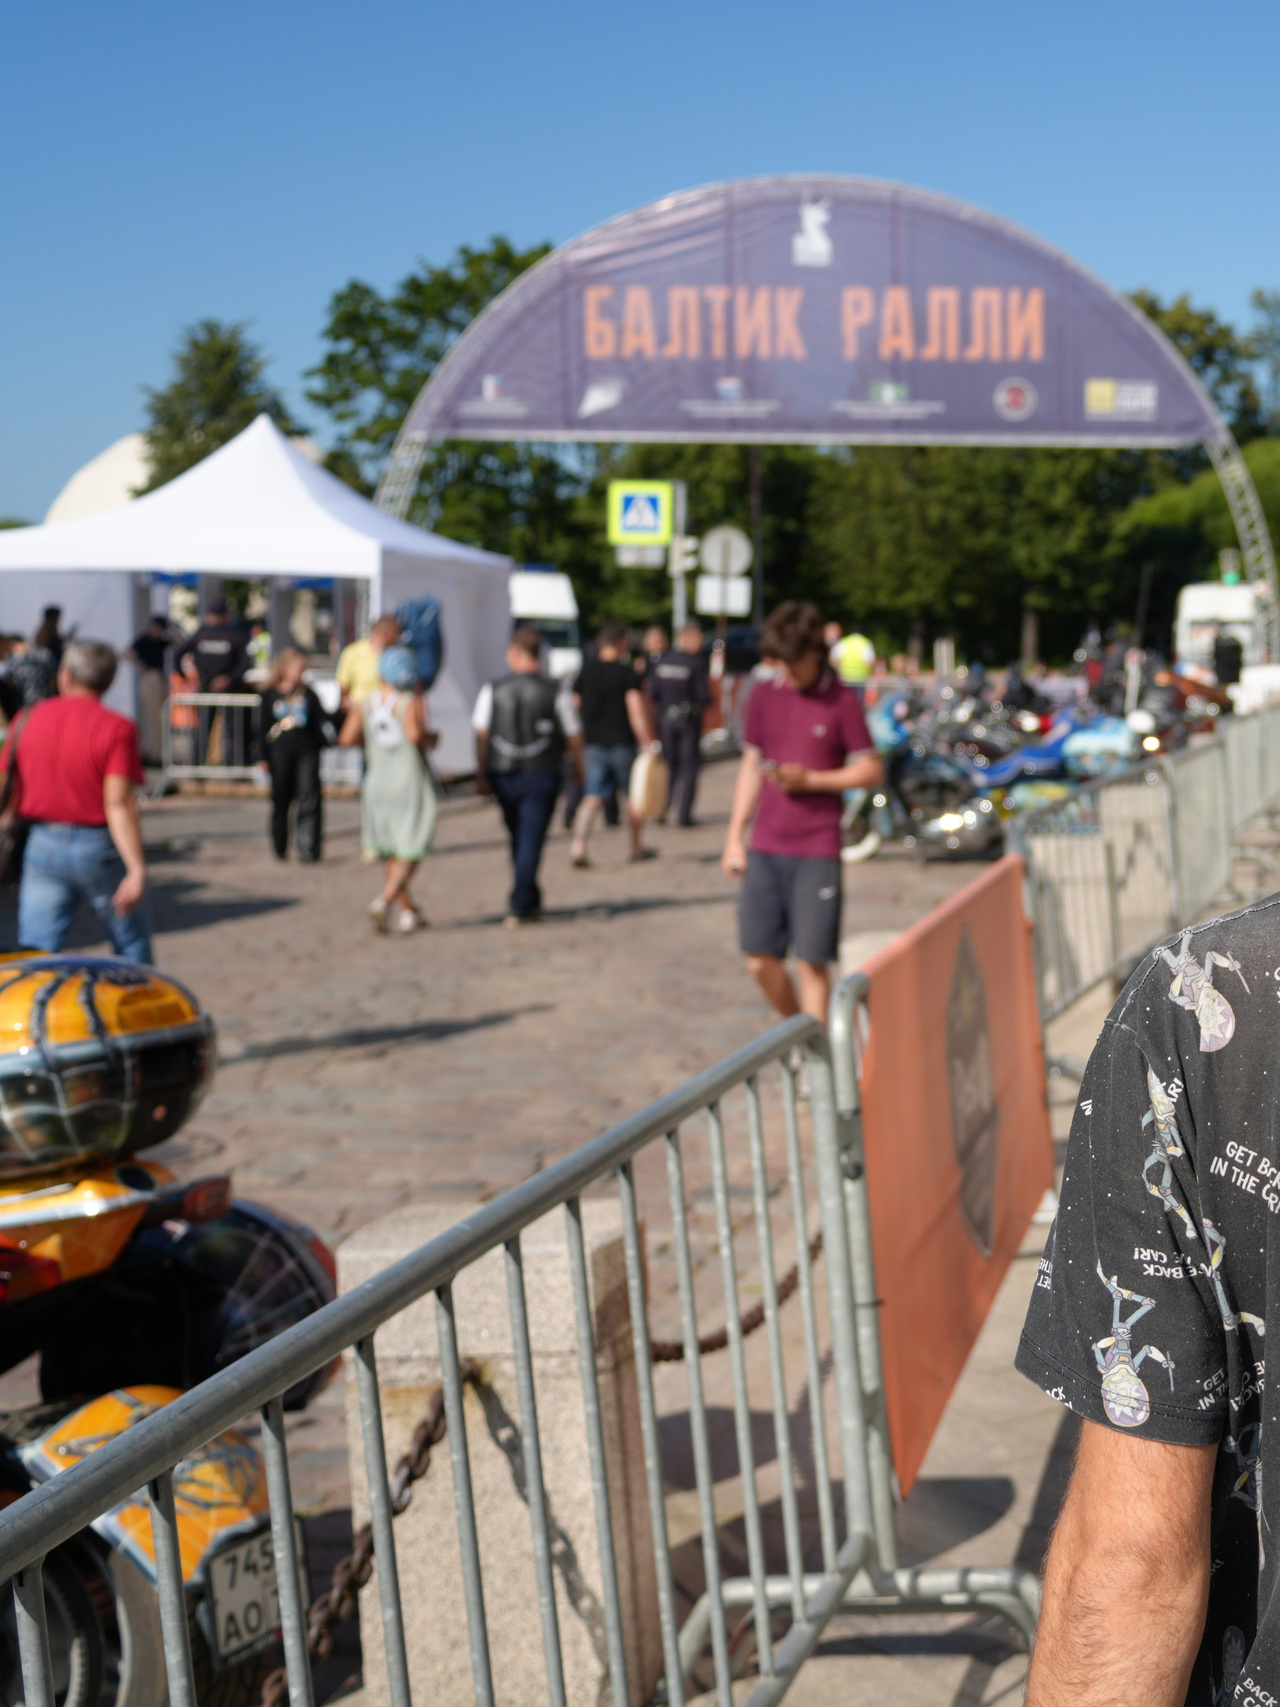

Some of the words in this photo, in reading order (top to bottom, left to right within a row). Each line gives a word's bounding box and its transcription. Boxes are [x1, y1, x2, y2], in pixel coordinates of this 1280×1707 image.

[584, 285, 807, 361] БАЛТИК
[841, 286, 1046, 362] РАЛЛИ
[1226, 1141, 1258, 1167] GET
[1209, 1156, 1229, 1177] IN
[1231, 1166, 1260, 1194] THE
[1133, 1247, 1168, 1264] CAR!
[1142, 1263, 1184, 1279] BACK
[1203, 1367, 1225, 1391] GET
[1198, 1392, 1216, 1410] IN
[1243, 1678, 1278, 1707] BACK
